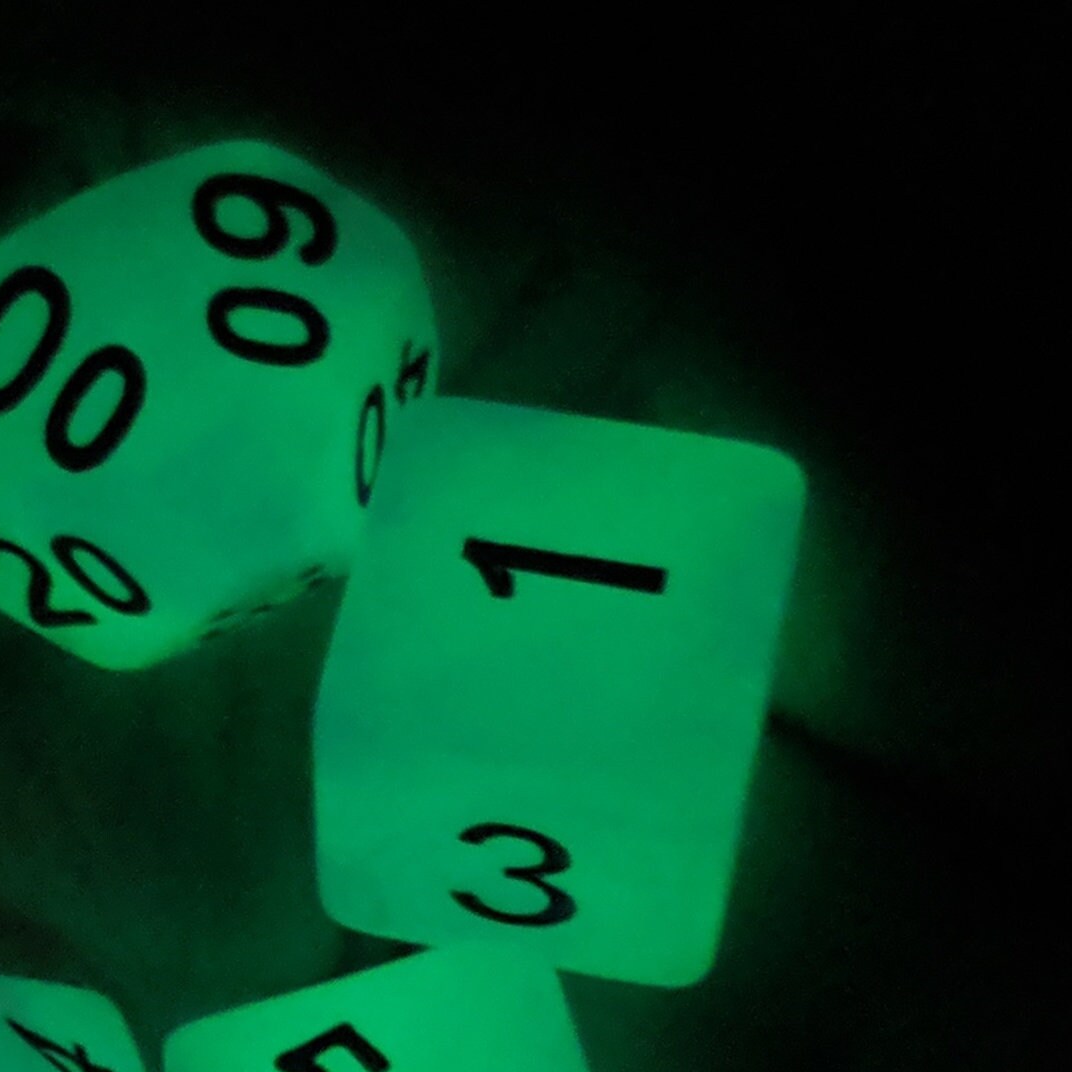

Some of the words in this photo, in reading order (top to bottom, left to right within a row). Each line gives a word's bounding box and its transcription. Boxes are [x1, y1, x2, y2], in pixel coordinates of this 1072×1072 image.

[190, 172, 338, 366] 60
[462, 536, 668, 599] 1
[451, 822, 577, 928] 3
